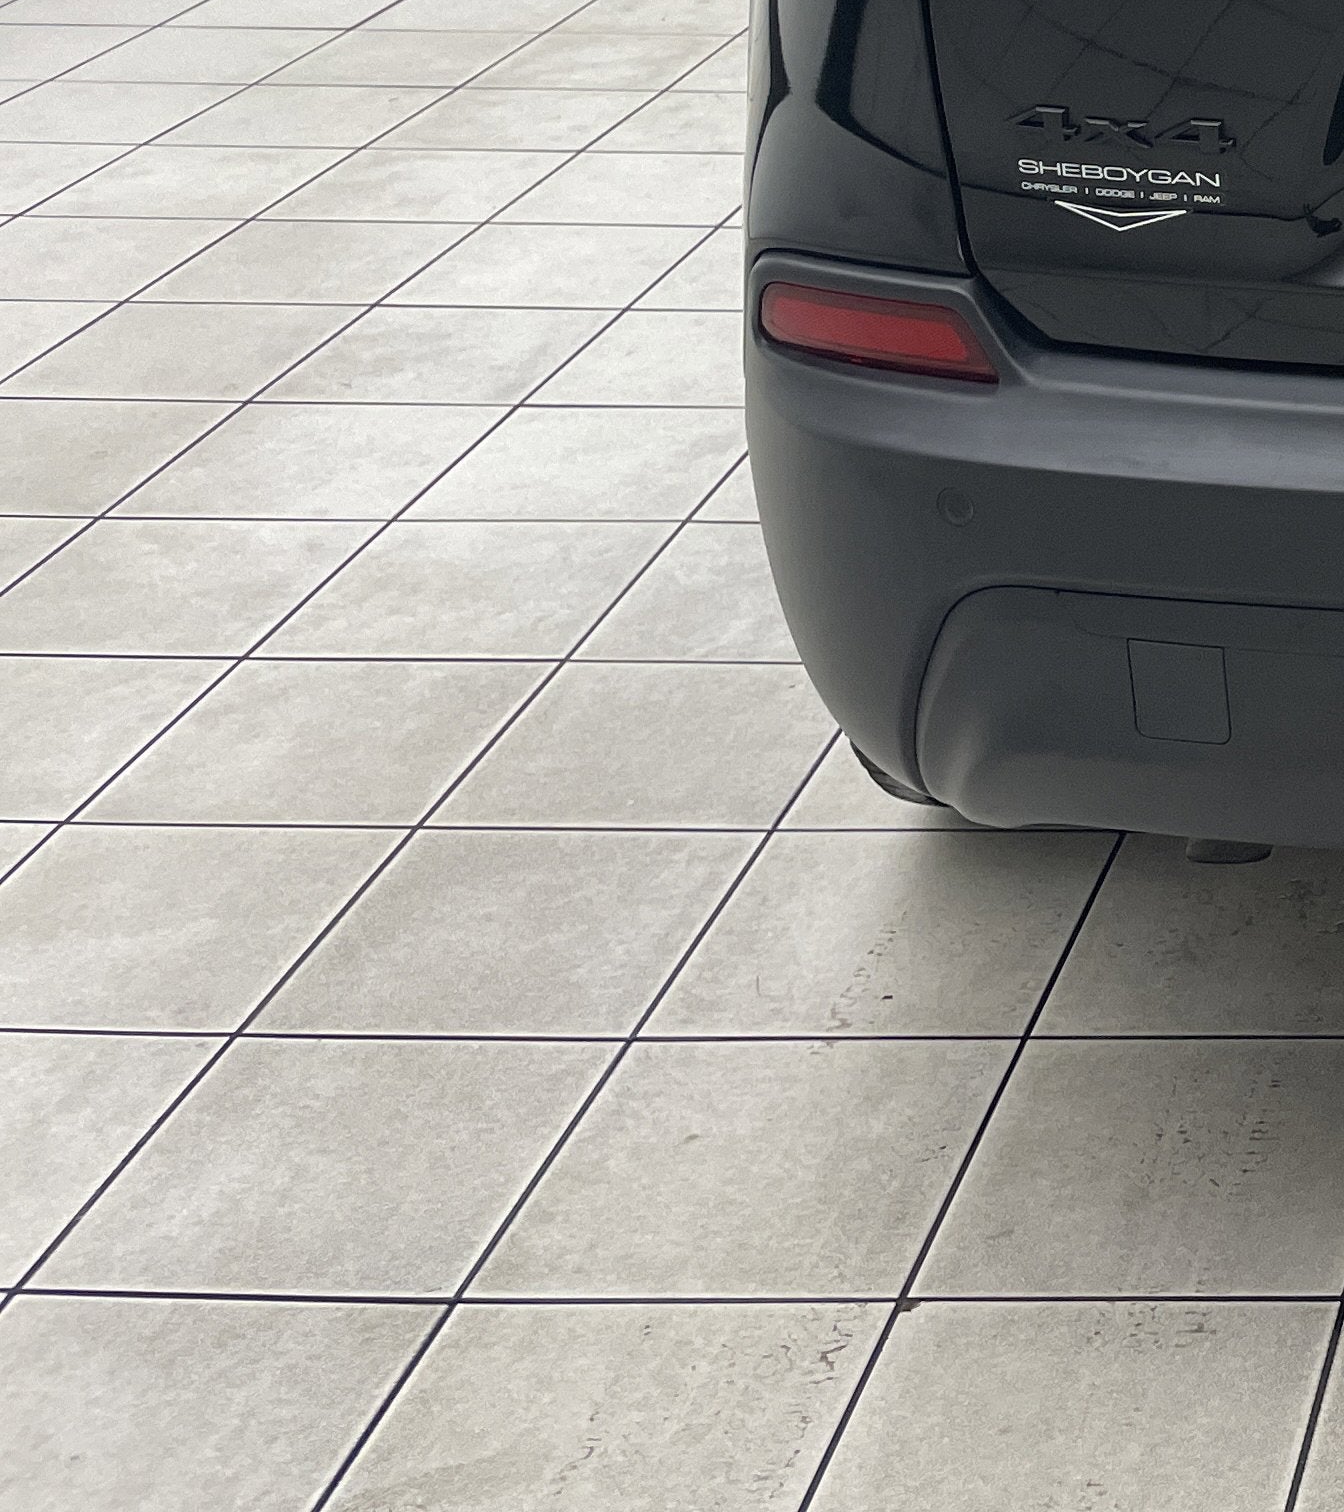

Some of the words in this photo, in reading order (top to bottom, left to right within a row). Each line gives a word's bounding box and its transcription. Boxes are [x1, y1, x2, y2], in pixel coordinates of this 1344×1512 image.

[1017, 159, 1221, 187] SHEBOYGAN
[1021, 182, 1077, 193] CHRYSLER
[1096, 188, 1135, 198] DODGE
[1149, 192, 1178, 201] JEEP
[1194, 195, 1221, 204] RAM
